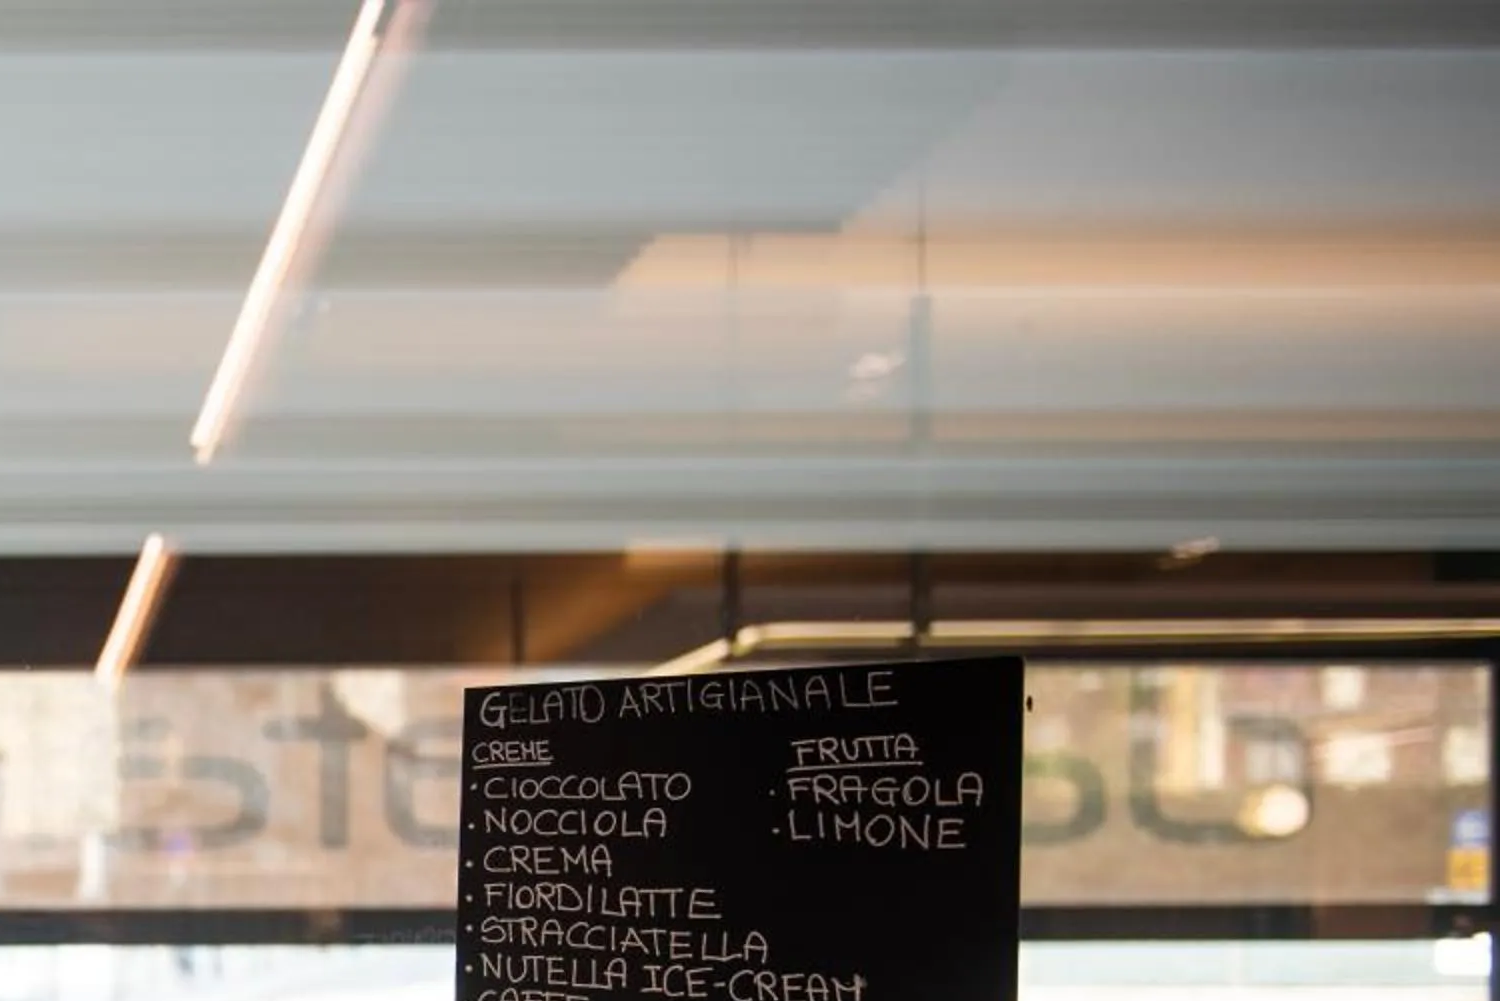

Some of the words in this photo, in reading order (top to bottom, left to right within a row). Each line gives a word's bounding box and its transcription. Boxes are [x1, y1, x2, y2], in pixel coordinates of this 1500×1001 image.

[480, 684, 605, 728] GELATO
[619, 671, 898, 719] ARTIGIANALE
[471, 740, 553, 763] CREME
[791, 733, 919, 764] FRUTTA
[484, 771, 691, 801] CIOCCOLATO
[788, 772, 983, 806] FRAGOLA
[484, 807, 666, 837] NOCCIOLA
[788, 809, 966, 849] LIMONE
[483, 844, 612, 877] CREMA
[481, 916, 768, 964] STRACCIATELLA
[481, 953, 627, 990] NUTELLA
